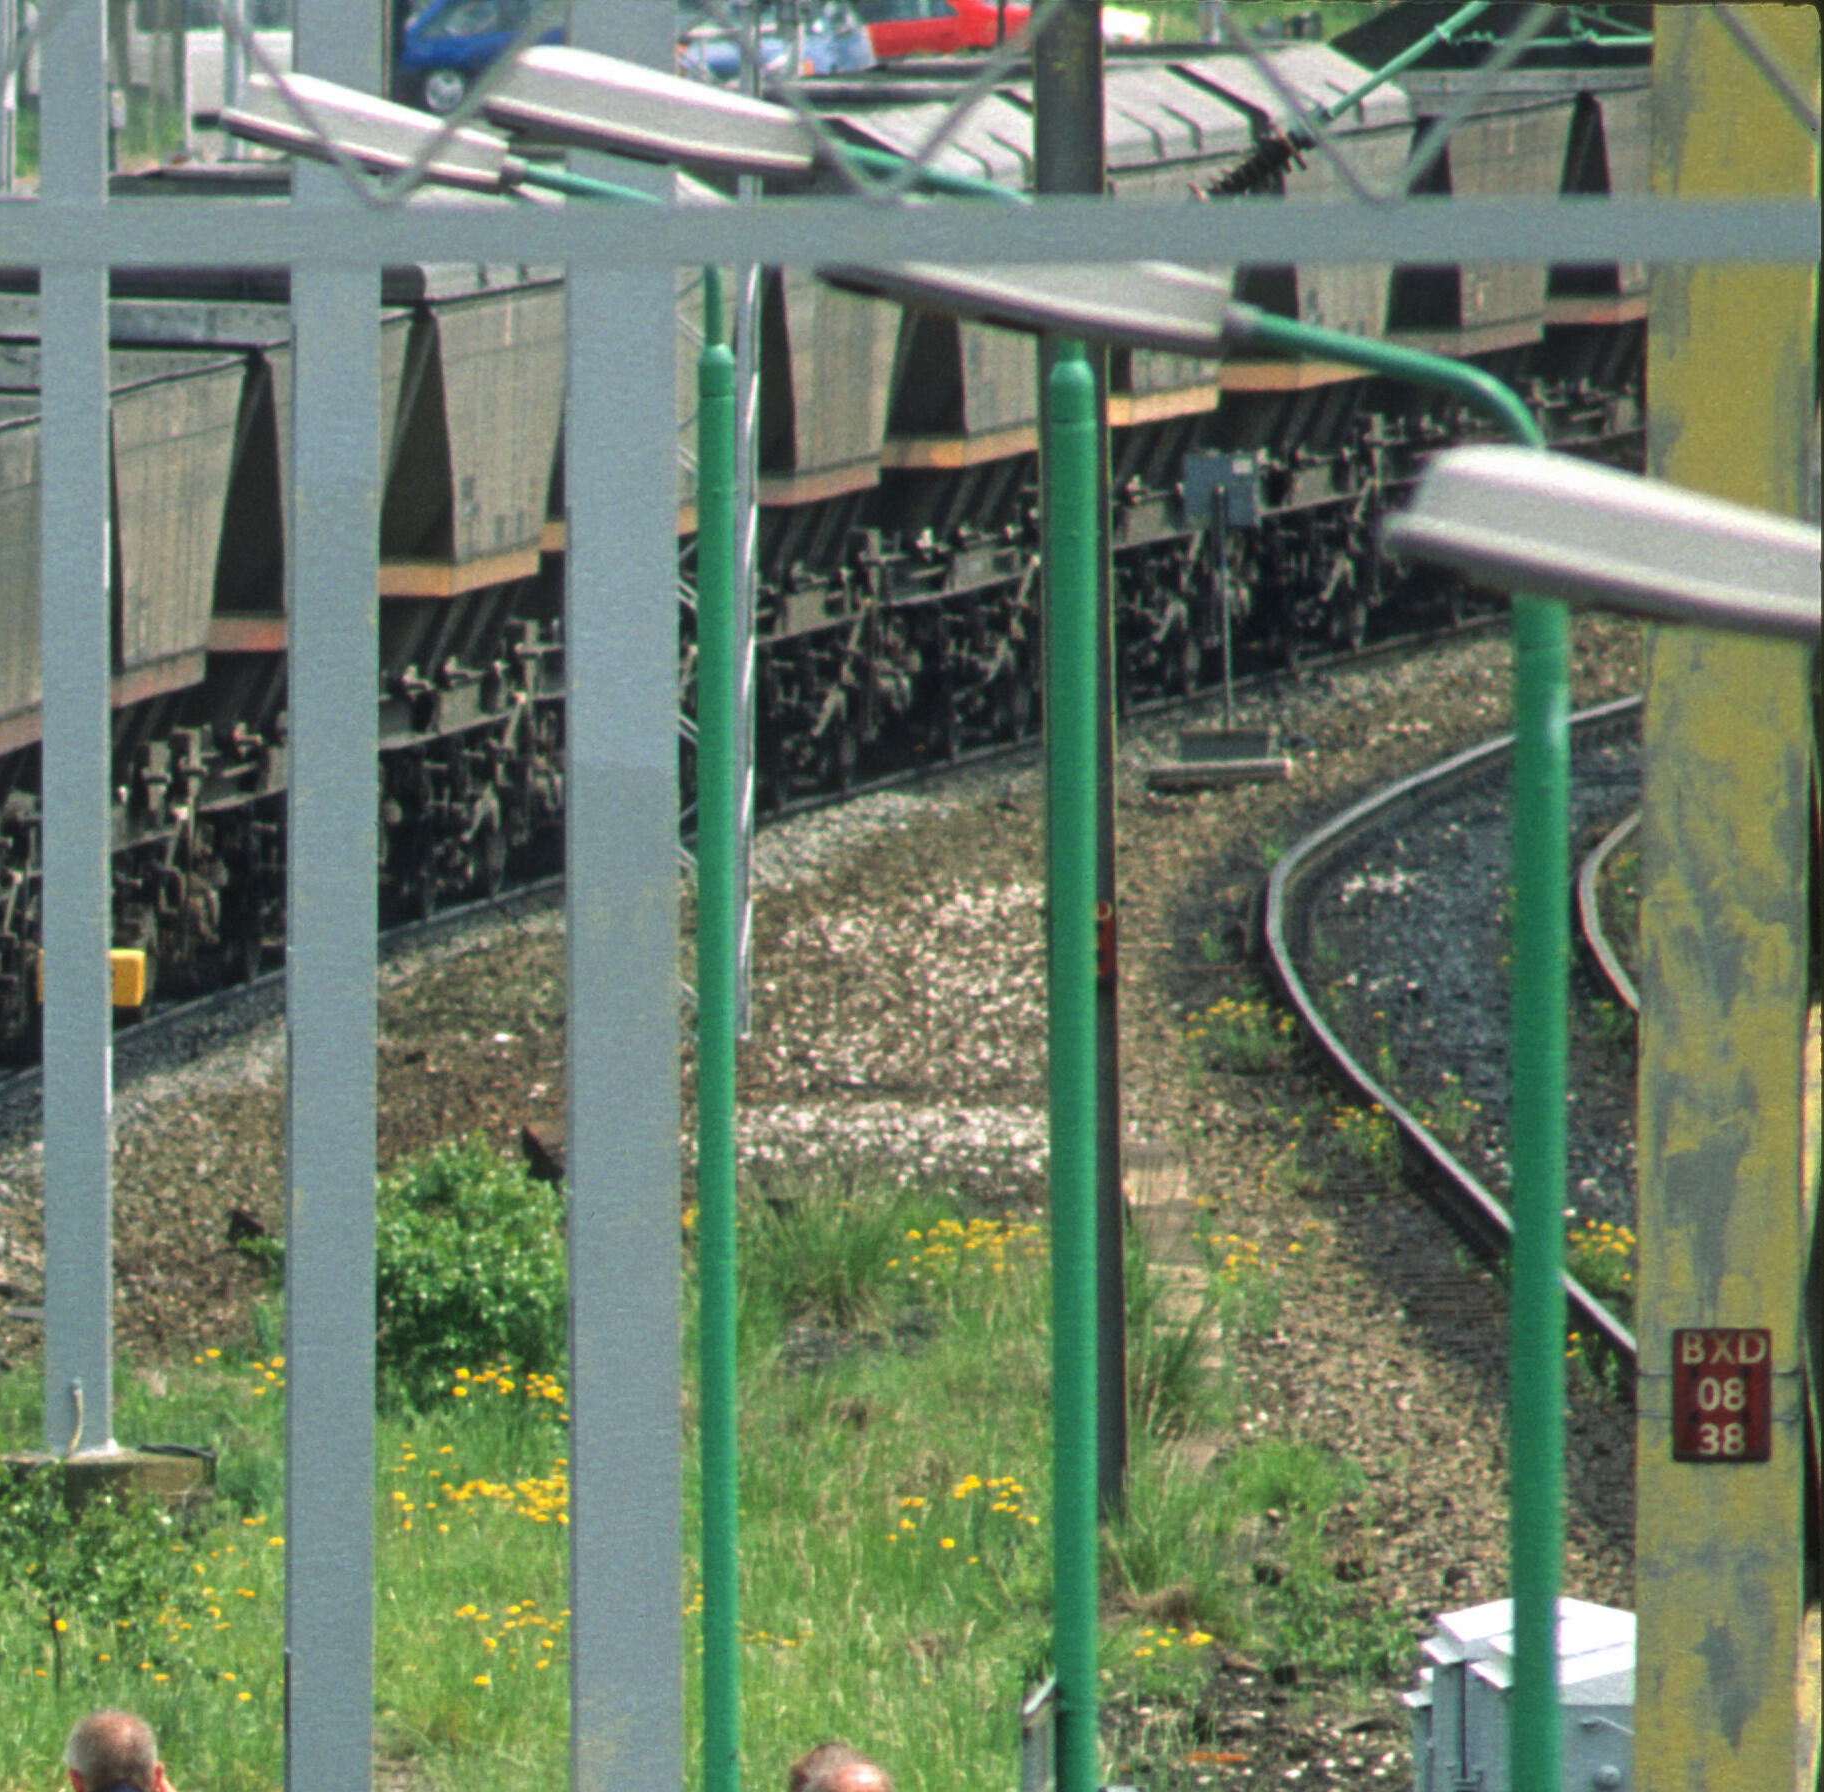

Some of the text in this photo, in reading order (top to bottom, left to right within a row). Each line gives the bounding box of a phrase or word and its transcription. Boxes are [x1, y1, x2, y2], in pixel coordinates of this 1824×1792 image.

[1682, 1331, 1767, 1365] BXD
[1698, 1376, 1746, 1412] 08
[1698, 1422, 1747, 1456] 38
